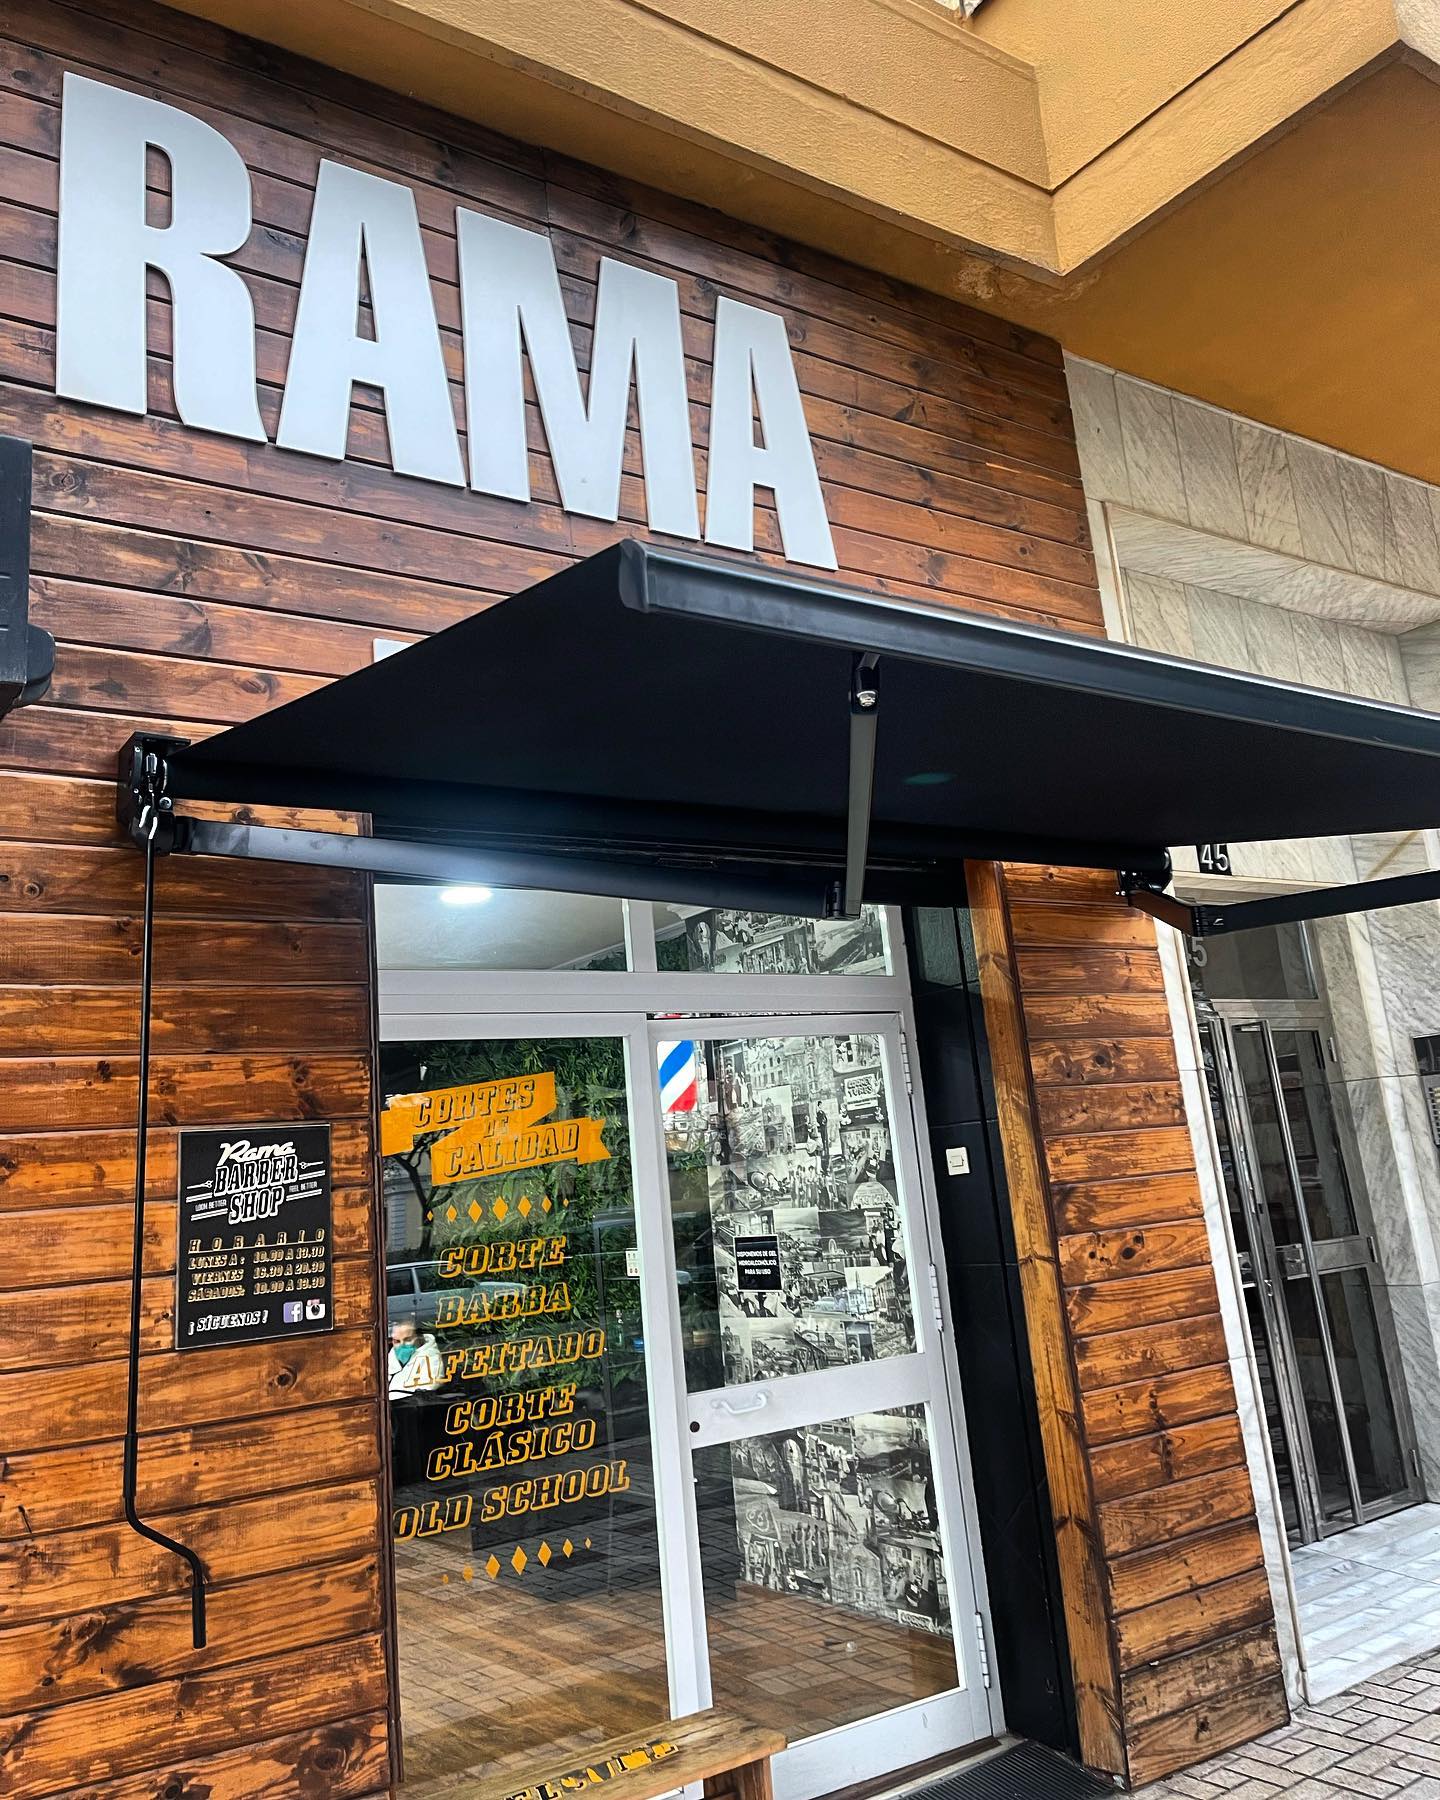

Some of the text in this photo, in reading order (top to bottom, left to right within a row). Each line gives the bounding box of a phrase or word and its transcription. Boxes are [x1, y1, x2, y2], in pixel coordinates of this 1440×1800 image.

[55, 71, 838, 571] RAMA
[1202, 844, 1228, 871] 45
[412, 1079, 536, 1128] CORTES
[216, 1140, 296, 1167] Rama
[443, 1123, 580, 1178] CALIDAD
[213, 1154, 298, 1197] BARBER
[228, 1185, 285, 1225] SHOP
[188, 1254, 228, 1270] LUNES
[253, 1249, 284, 1264] 10.00
[284, 1248, 294, 1260] A
[192, 1269, 244, 1286] VIERNES
[284, 1264, 293, 1276] A
[295, 1261, 325, 1275] 20.30
[438, 1235, 567, 1278] CORTE
[285, 1280, 294, 1292] A
[435, 1282, 572, 1328] BARBA
[403, 1328, 605, 1388] AFEITADO
[445, 1383, 577, 1435] CORTE
[426, 1418, 597, 1481] CLÁSICO
[393, 1460, 632, 1544] OLD SCHOOL
